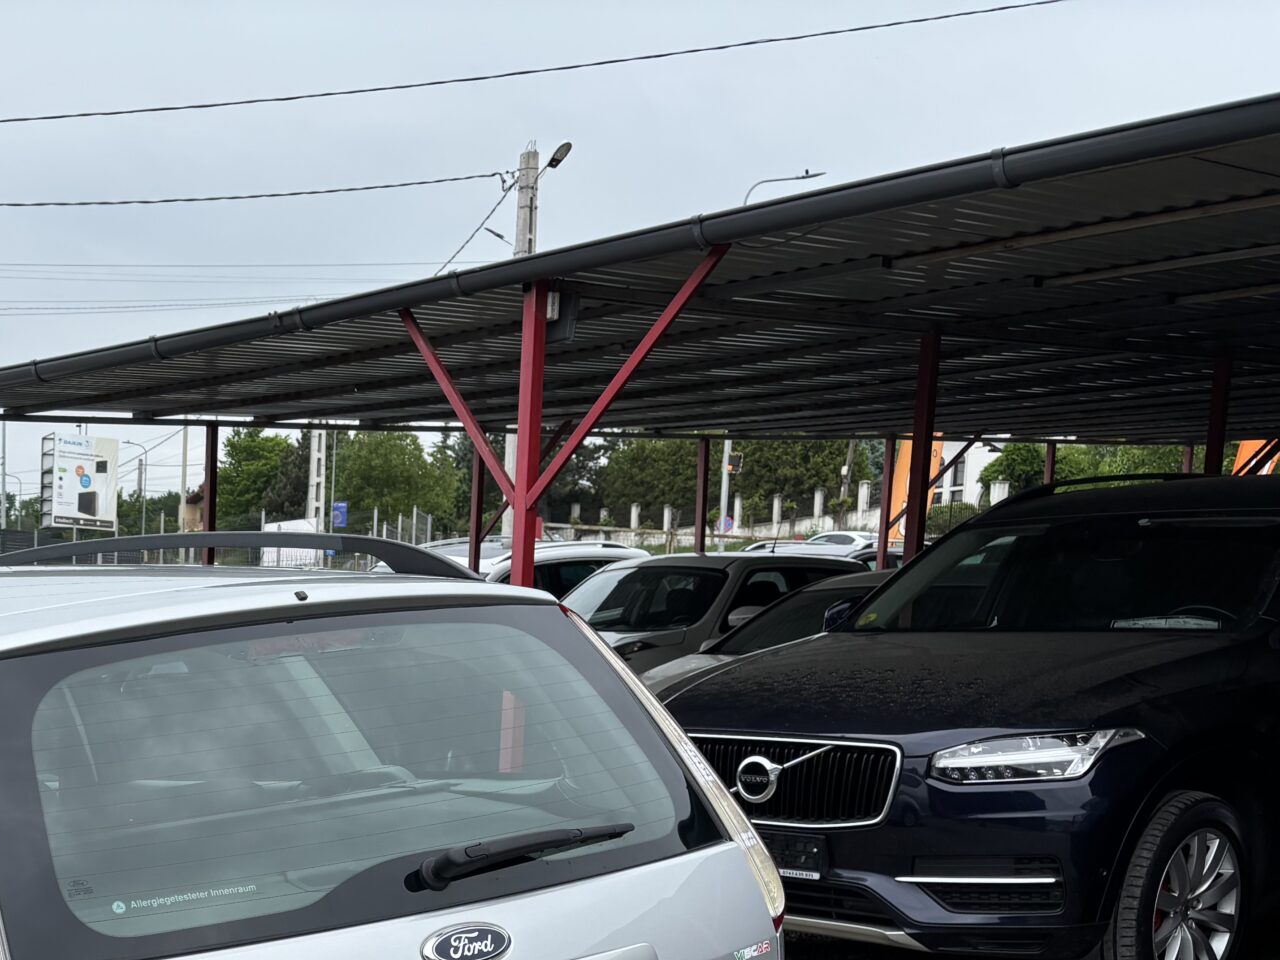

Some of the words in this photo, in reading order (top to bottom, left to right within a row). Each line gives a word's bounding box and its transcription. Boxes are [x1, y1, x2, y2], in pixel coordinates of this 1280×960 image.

[740, 775, 769, 783] VOLVO
[130, 890, 209, 909] Allergiegetesteter
[210, 883, 257, 898] Innenraum
[449, 931, 495, 959] Ford
